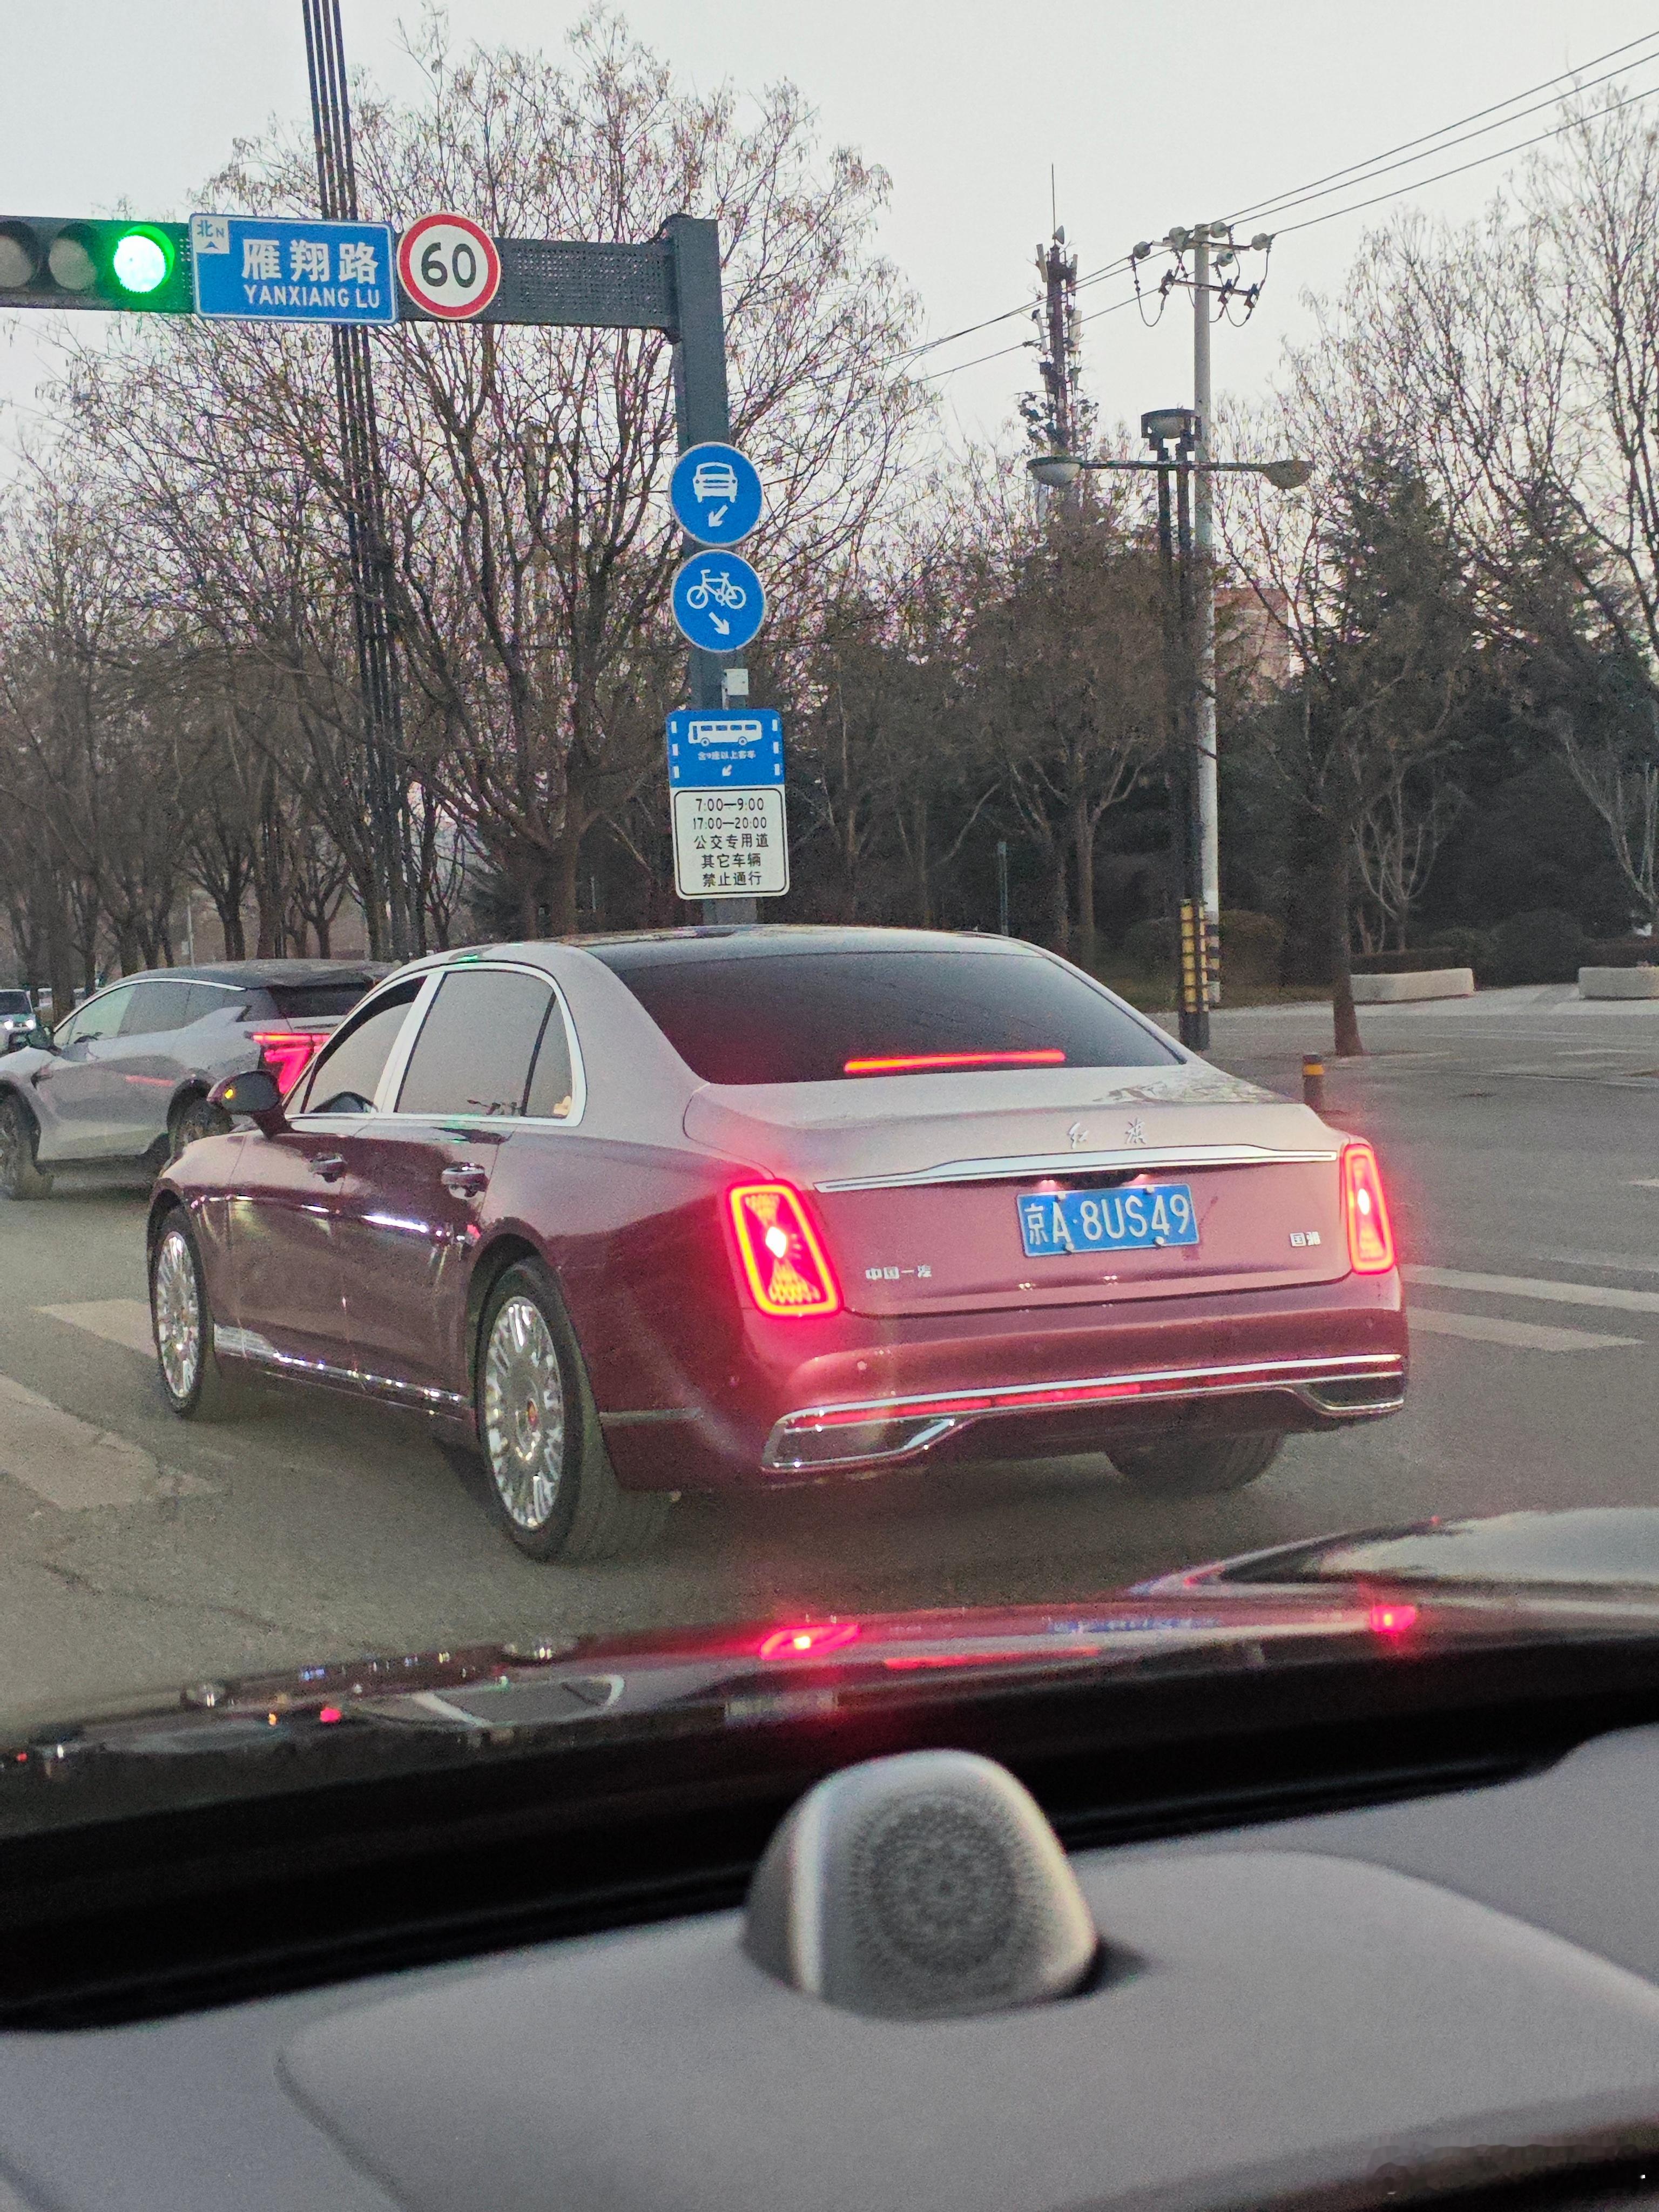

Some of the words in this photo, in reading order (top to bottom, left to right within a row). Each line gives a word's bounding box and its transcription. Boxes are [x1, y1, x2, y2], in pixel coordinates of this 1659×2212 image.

[196, 219, 213, 237] 北
[217, 229, 225, 237] N
[241, 239, 379, 285] 雁翔路
[421, 242, 477, 288] 60
[243, 284, 350, 306] YANXIANG
[356, 288, 380, 308] LU
[693, 833, 769, 850] 公交专用道
[701, 853, 761, 869] 其它车辆
[703, 871, 762, 888] 禁止通行
